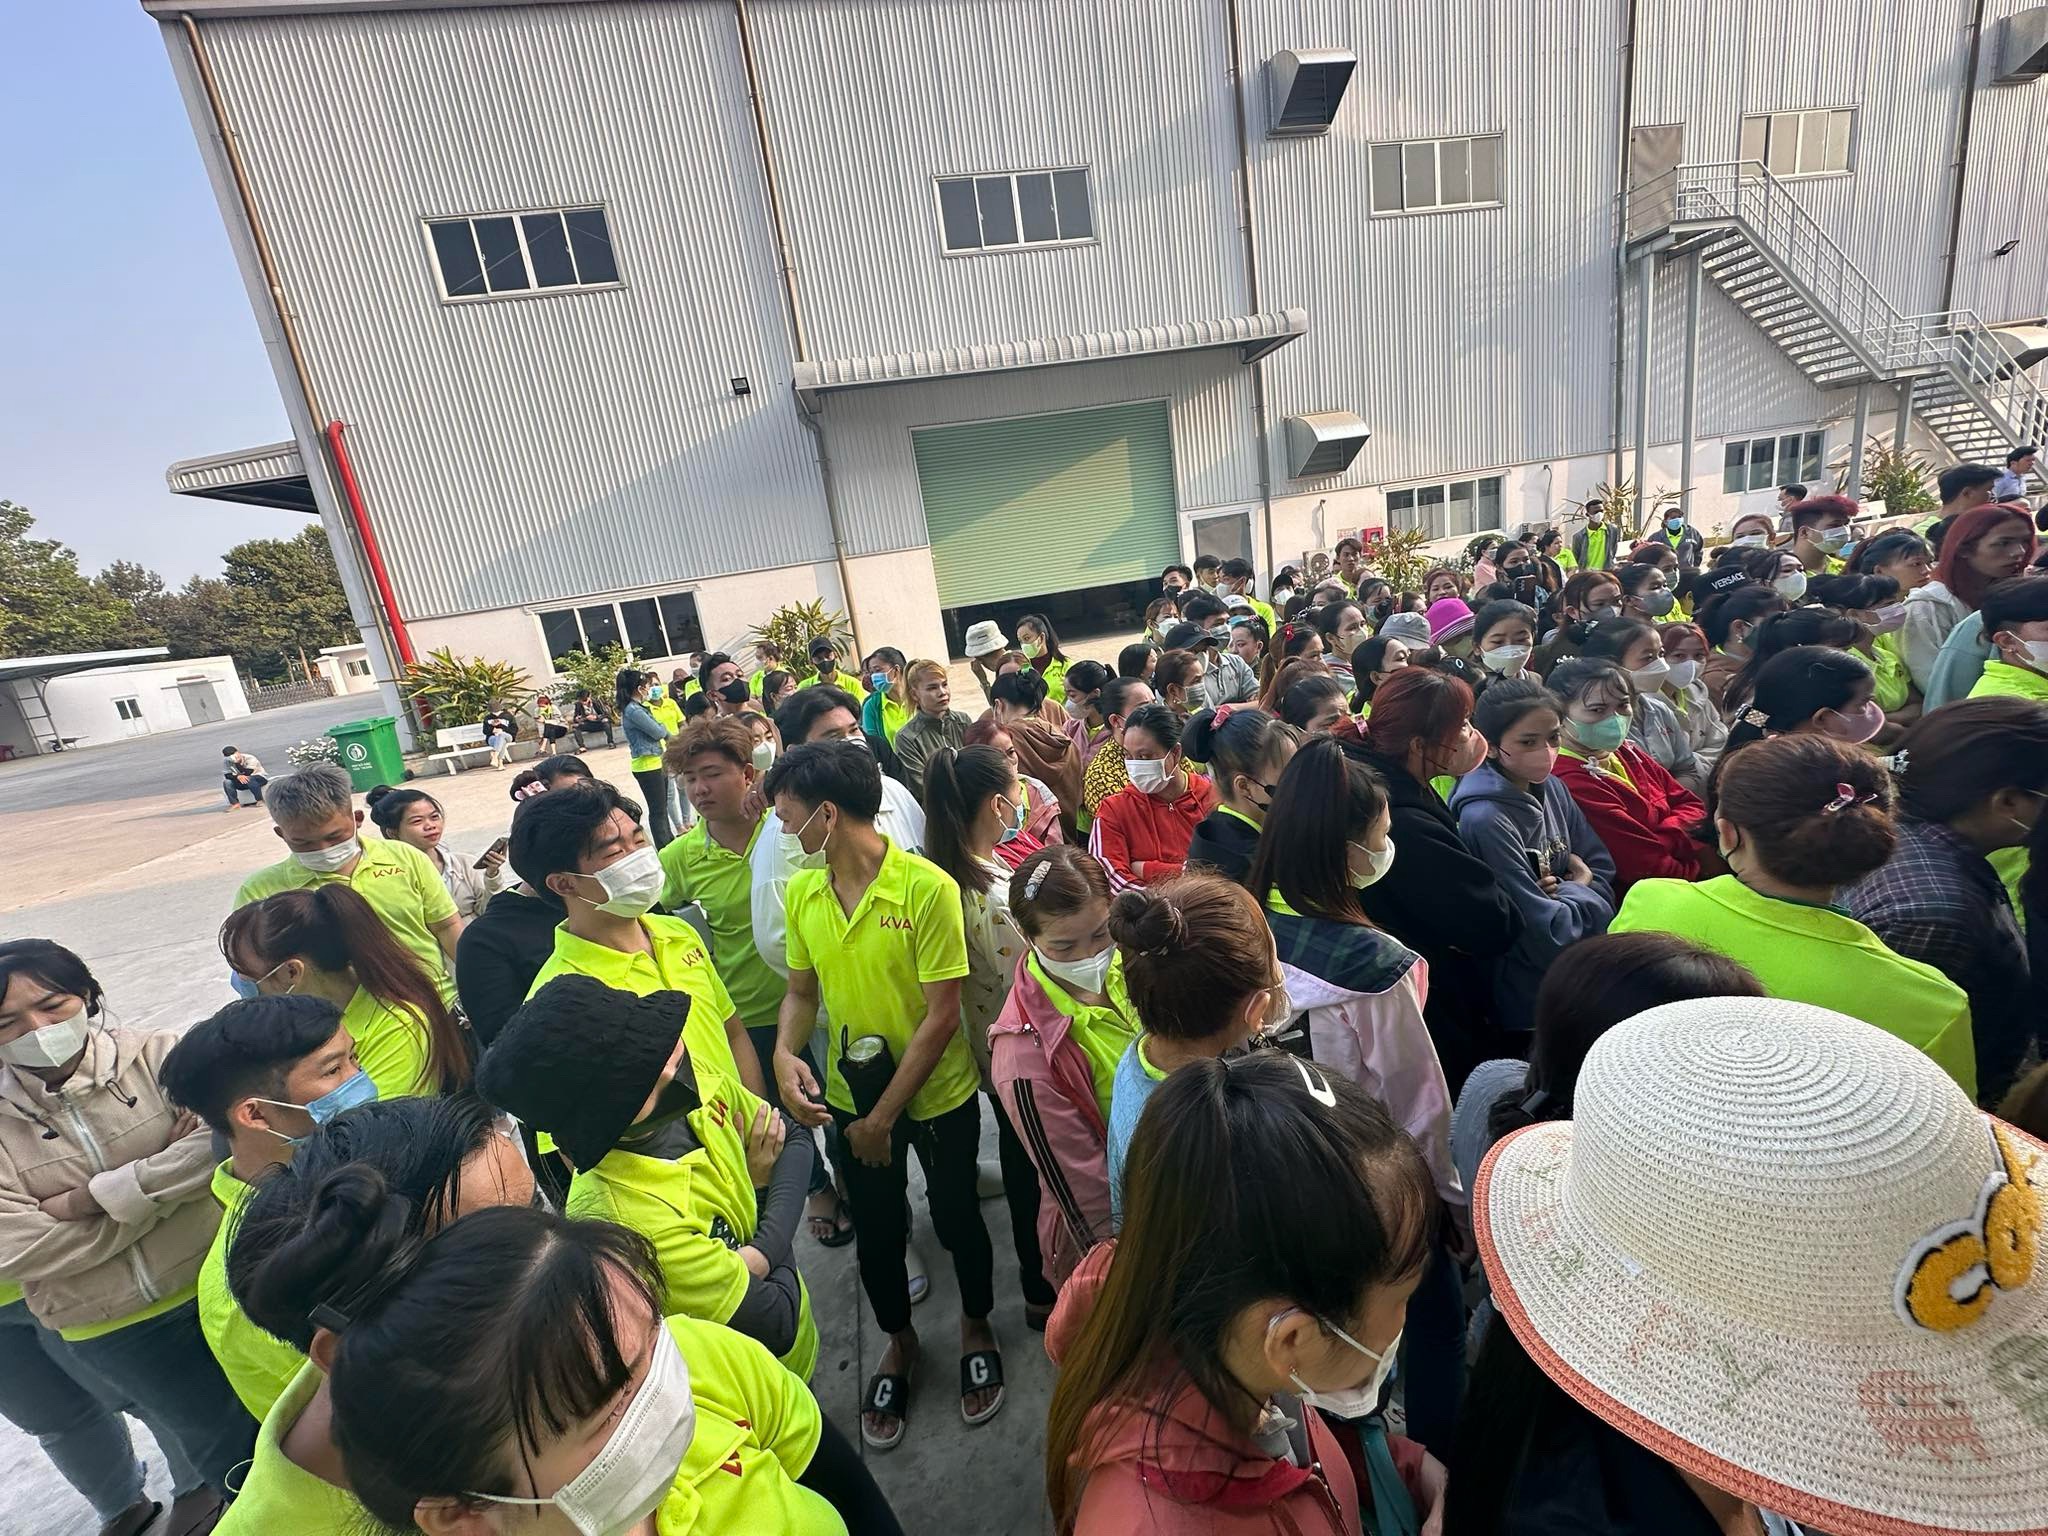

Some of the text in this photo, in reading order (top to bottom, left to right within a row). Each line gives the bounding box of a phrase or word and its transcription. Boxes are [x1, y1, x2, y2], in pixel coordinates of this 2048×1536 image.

[1711, 572, 1746, 590] VERSACE
[373, 868, 405, 879] KVA
[880, 915, 913, 932] KVA
[968, 1356, 989, 1385] G
[873, 1378, 893, 1408] G
